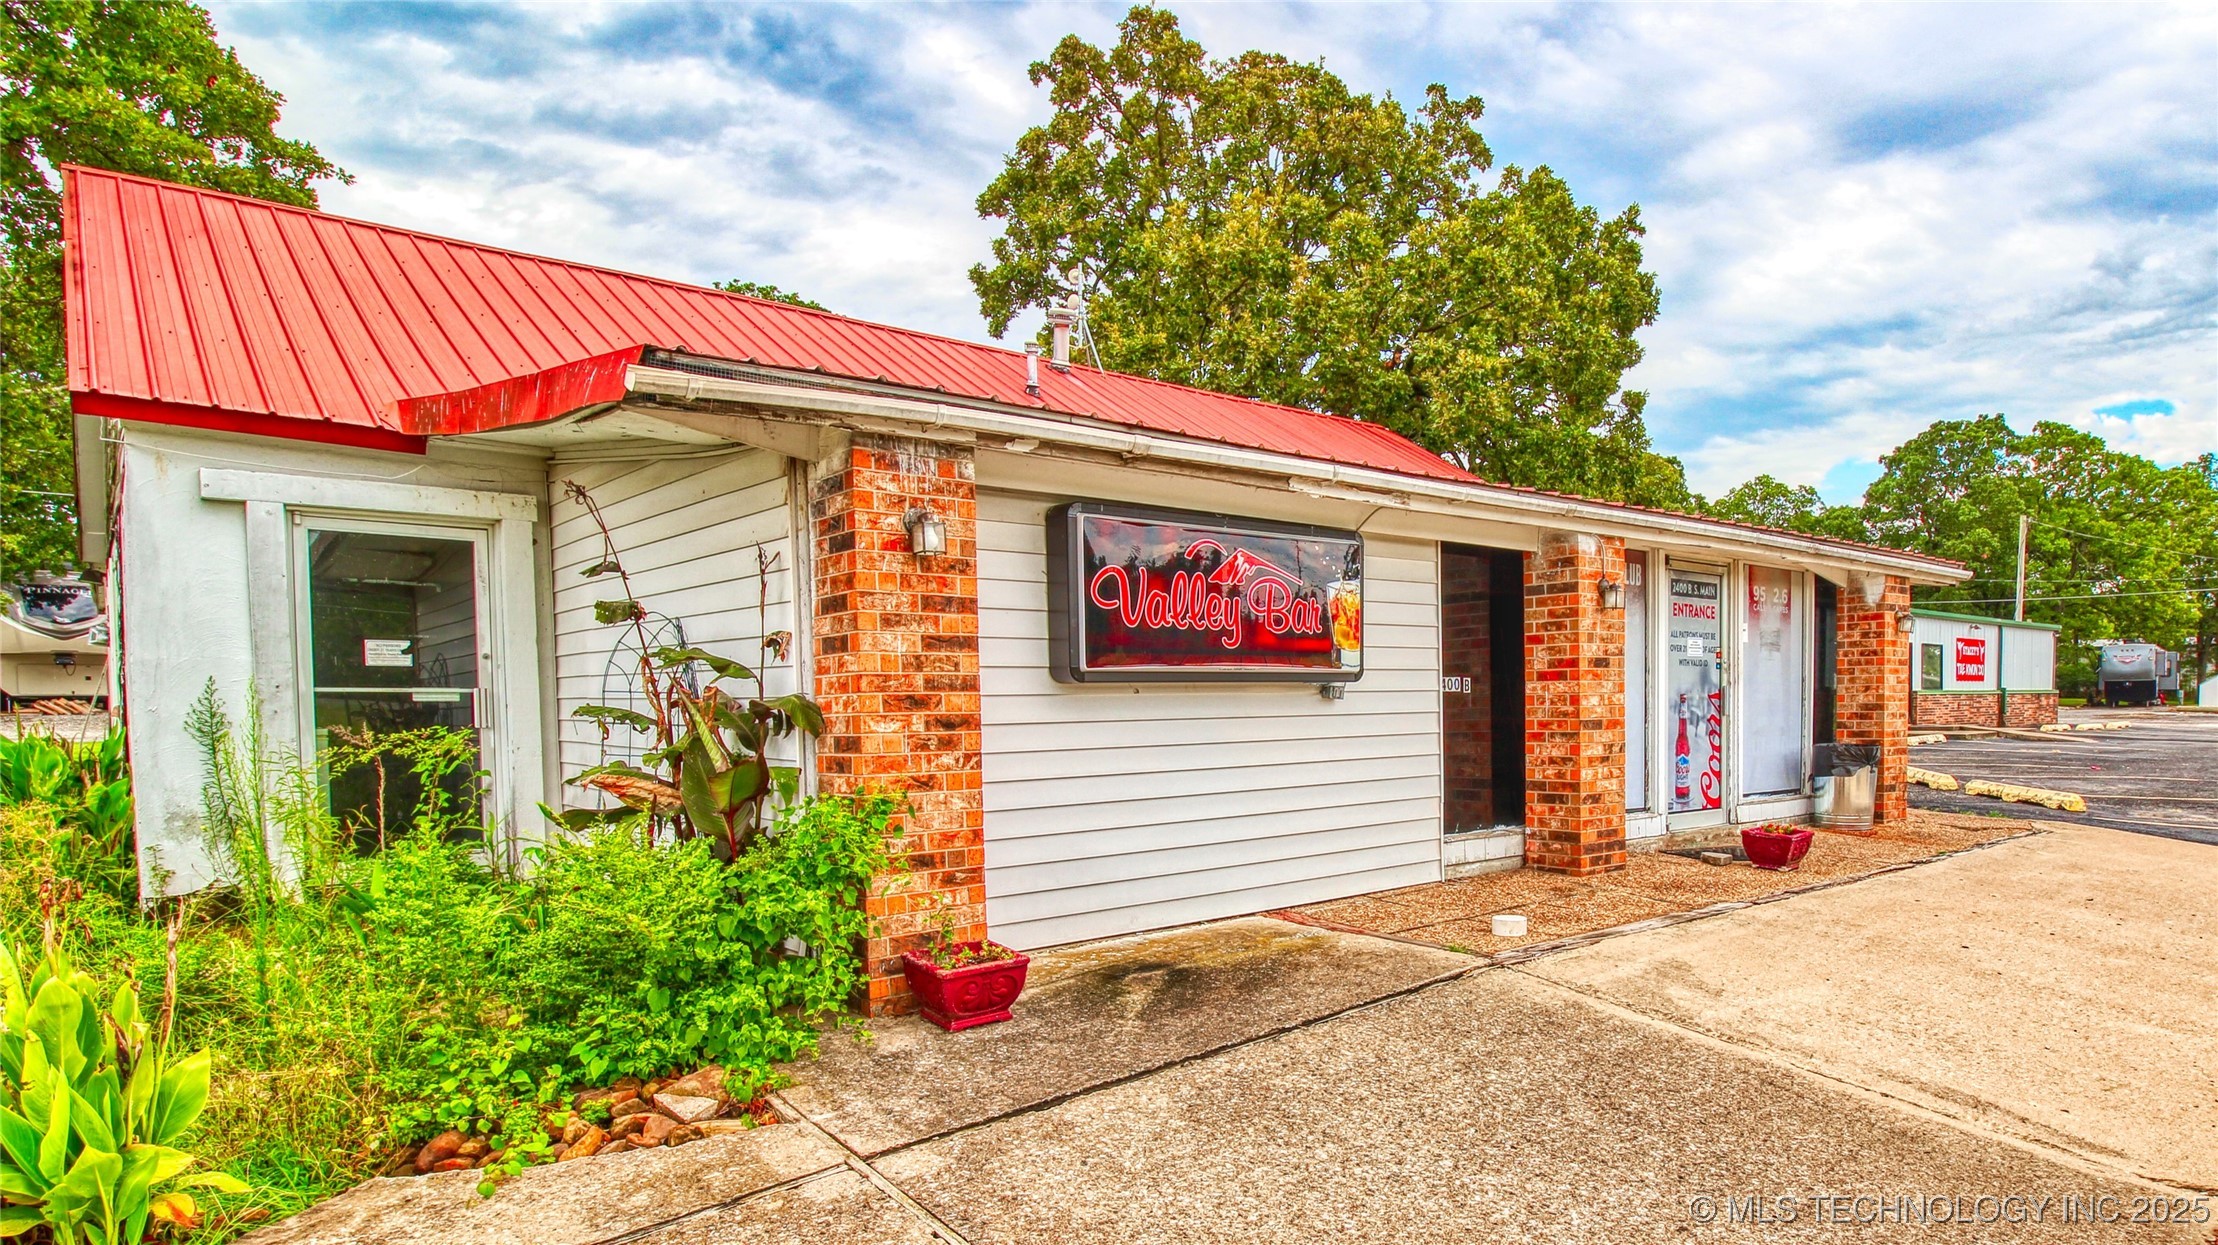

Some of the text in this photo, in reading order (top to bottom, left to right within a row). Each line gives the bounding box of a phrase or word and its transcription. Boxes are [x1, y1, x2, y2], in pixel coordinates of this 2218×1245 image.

[1672, 582, 1687, 594] 2400
[1700, 585, 1716, 596] MAIN
[1753, 586, 1788, 604] 95 2.6
[1090, 564, 1322, 649] Valley Bar
[1673, 602, 1716, 619] ENTRANCE
[1679, 631, 1698, 639] PATRONS
[1699, 632, 1710, 640] MUST
[1711, 632, 1716, 640] BE
[1670, 644, 1682, 652] OVER
[1690, 659, 1702, 667] VALID
[1464, 678, 1470, 691] B
